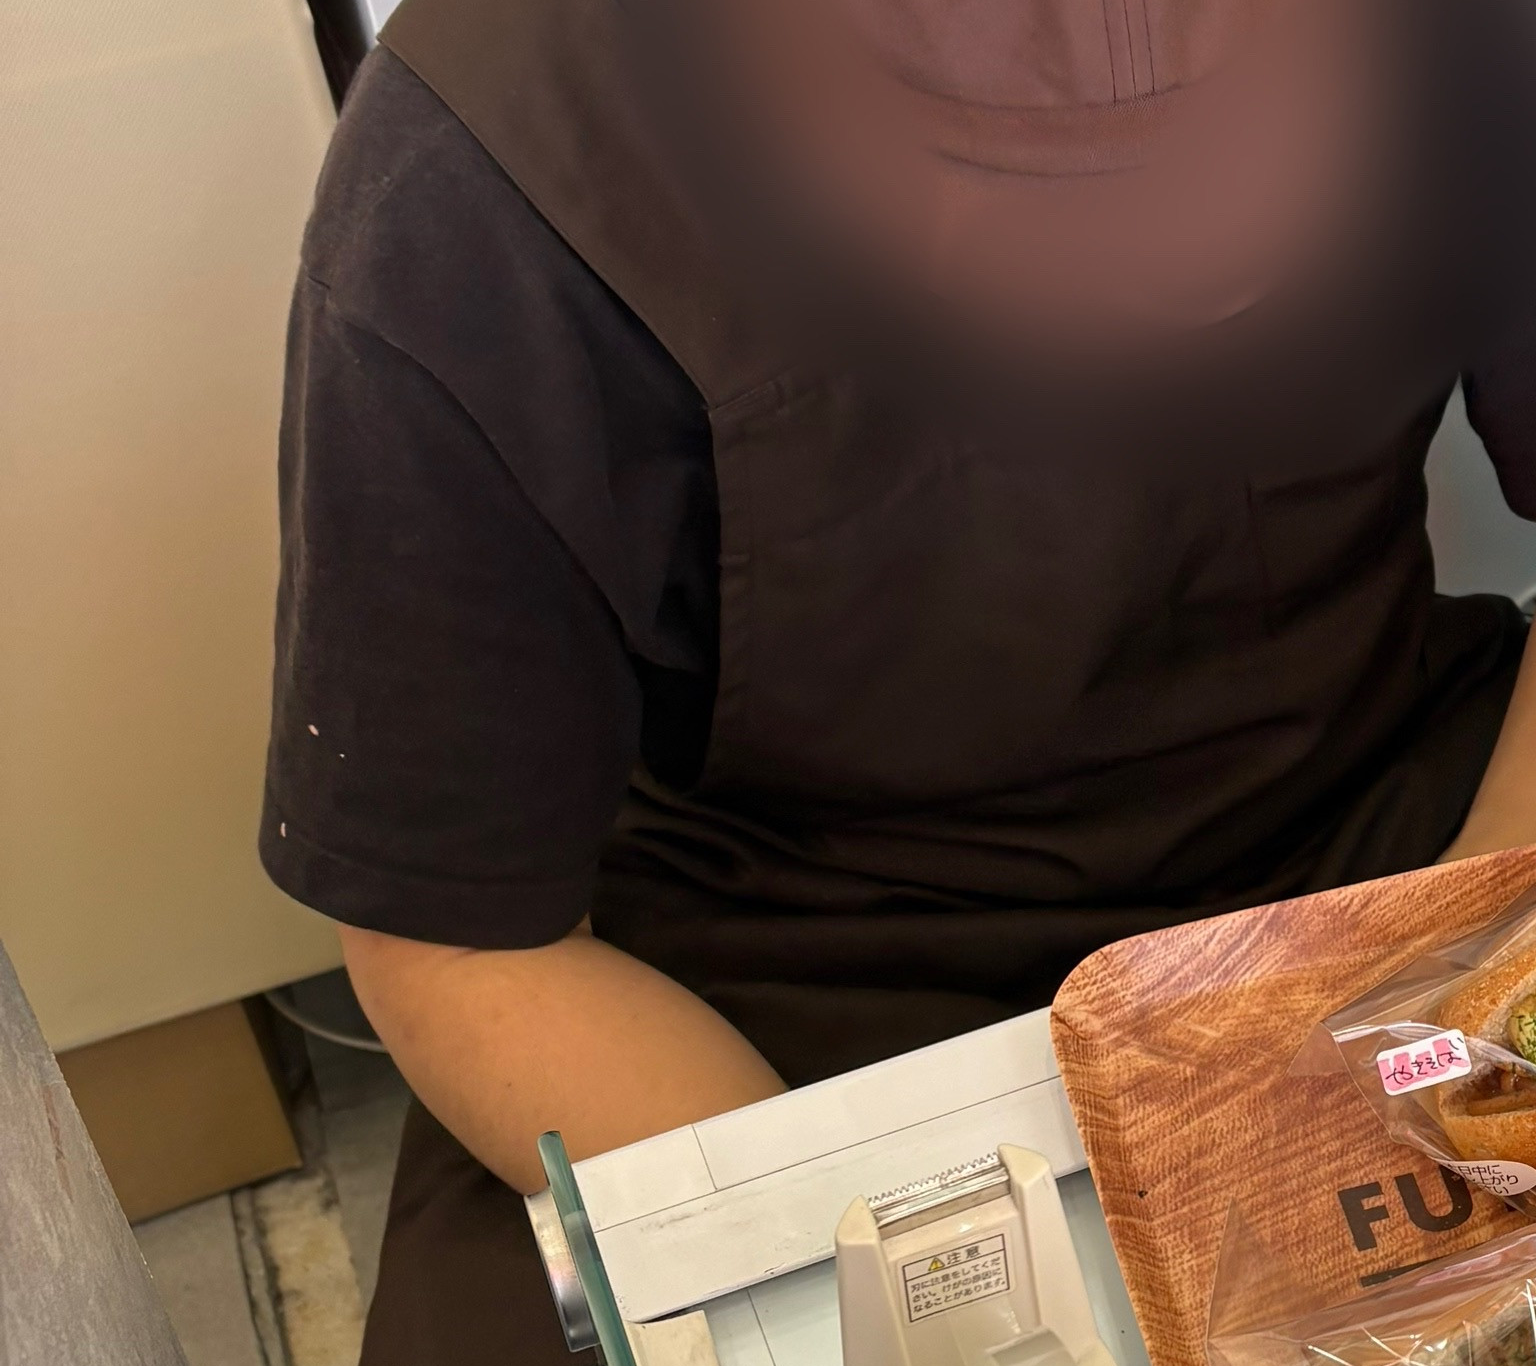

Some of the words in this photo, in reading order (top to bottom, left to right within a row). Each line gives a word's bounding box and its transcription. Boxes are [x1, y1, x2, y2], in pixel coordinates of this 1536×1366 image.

[1385, 1037, 1465, 1085] やきそば
[1448, 1164, 1502, 1176] 日中に
[947, 1246, 981, 1265] 注意
[913, 1278, 1007, 1313] なることがあります。
